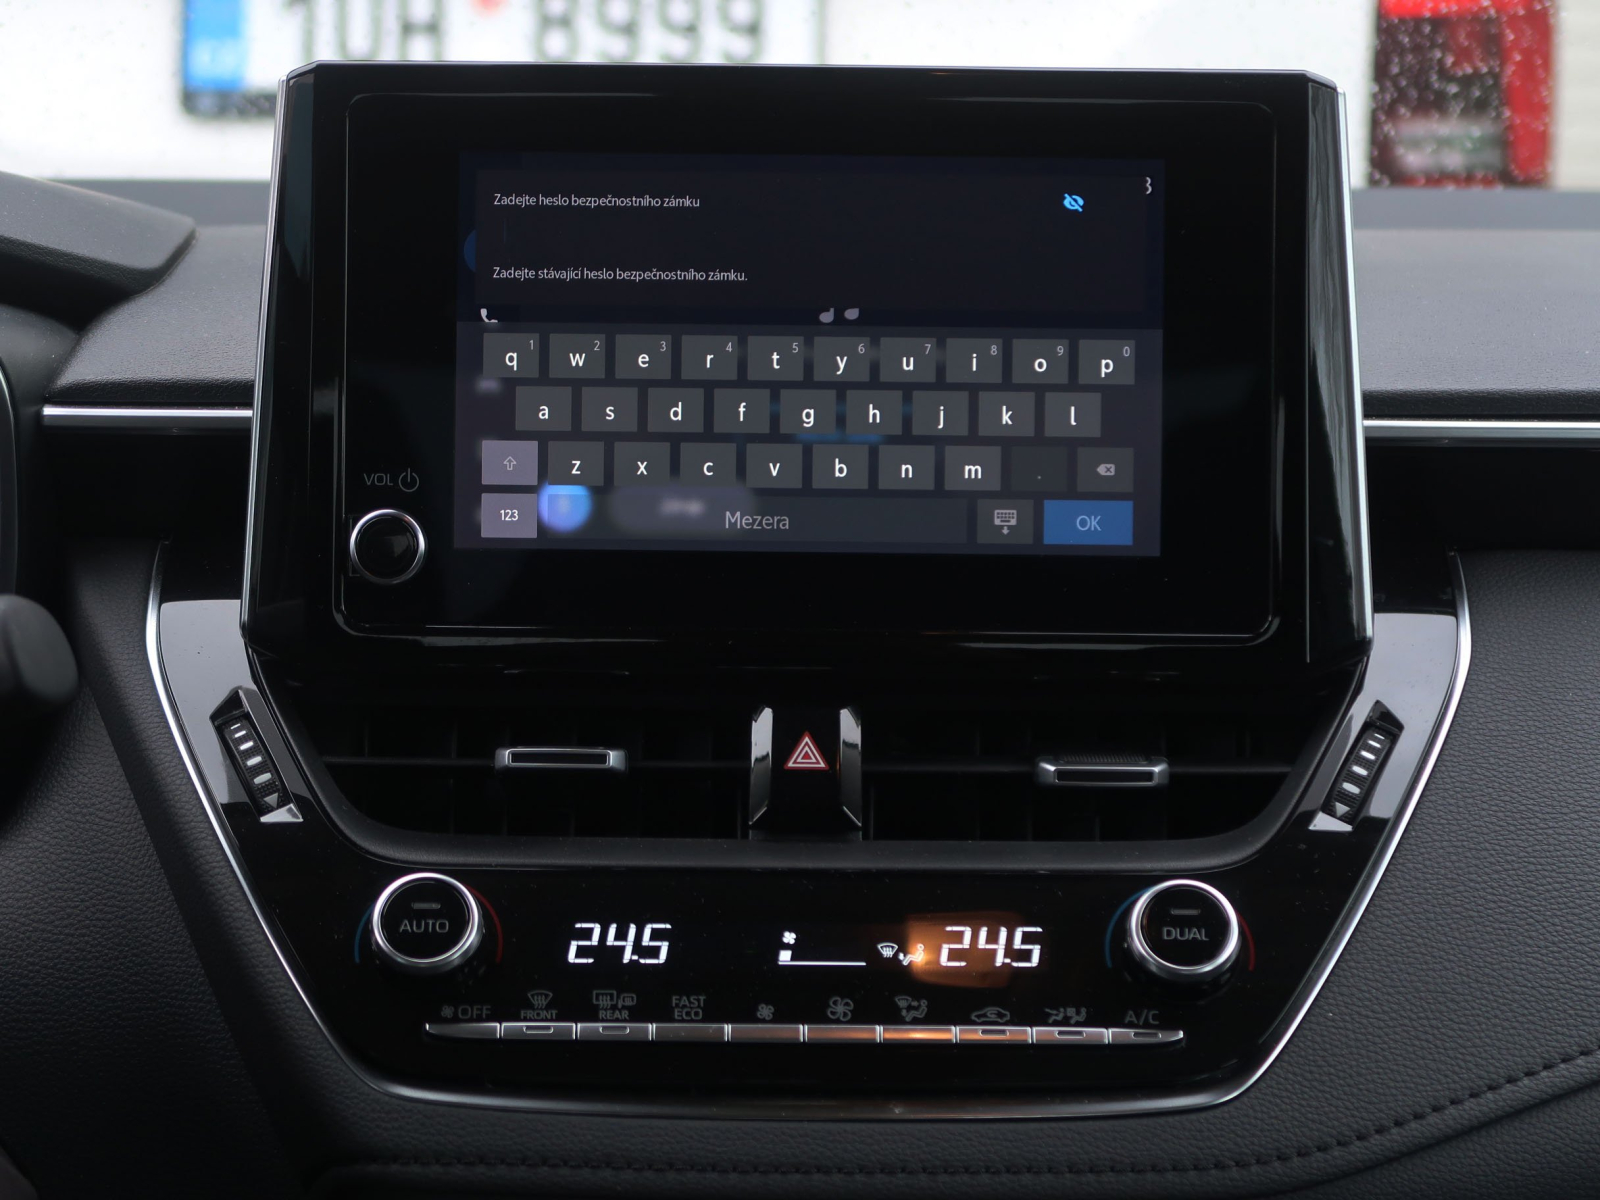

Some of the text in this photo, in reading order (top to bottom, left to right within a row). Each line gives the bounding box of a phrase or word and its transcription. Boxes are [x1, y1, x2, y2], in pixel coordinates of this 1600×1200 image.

[493, 193, 700, 209] Zadejte heslo bezpečnostního zámku
[492, 266, 748, 283] Zadejte stávající heslo bezpečnostního zámku.
[529, 339, 1131, 357] 1 2 3 4 5 6 7 8 9 0
[505, 352, 518, 371] q
[569, 352, 586, 367] w
[637, 353, 650, 368] e
[705, 353, 715, 369] r
[771, 351, 781, 370] t
[836, 355, 848, 375] y
[902, 356, 914, 371] u
[1034, 358, 1047, 373] o
[1100, 359, 1114, 378] p
[538, 405, 549, 420] a
[605, 406, 615, 420] s
[669, 401, 682, 421] d
[738, 402, 747, 422] f
[801, 408, 815, 428] g
[868, 403, 881, 424] h
[1002, 405, 1013, 425] k
[571, 460, 581, 475] z
[636, 461, 648, 476] x
[703, 461, 714, 476] c
[769, 462, 781, 477] v
[834, 457, 848, 478] b
[901, 464, 913, 479] n
[964, 464, 982, 479] m
[363, 473, 394, 486] VOL
[499, 509, 519, 521] 123
[725, 510, 789, 530] Mezera
[1076, 515, 1102, 531] OK
[399, 919, 449, 933] AUTO
[1162, 926, 1209, 941] DUAL
[567, 922, 672, 964] 24.5
[939, 925, 1043, 968] 24.5
[672, 995, 707, 1008] FAST
[457, 1005, 492, 1019] OFF
[519, 1009, 558, 1020] FRONT
[598, 1009, 630, 1020] REAR
[674, 1008, 703, 1020] ECO
[1124, 1009, 1161, 1025] A/C
